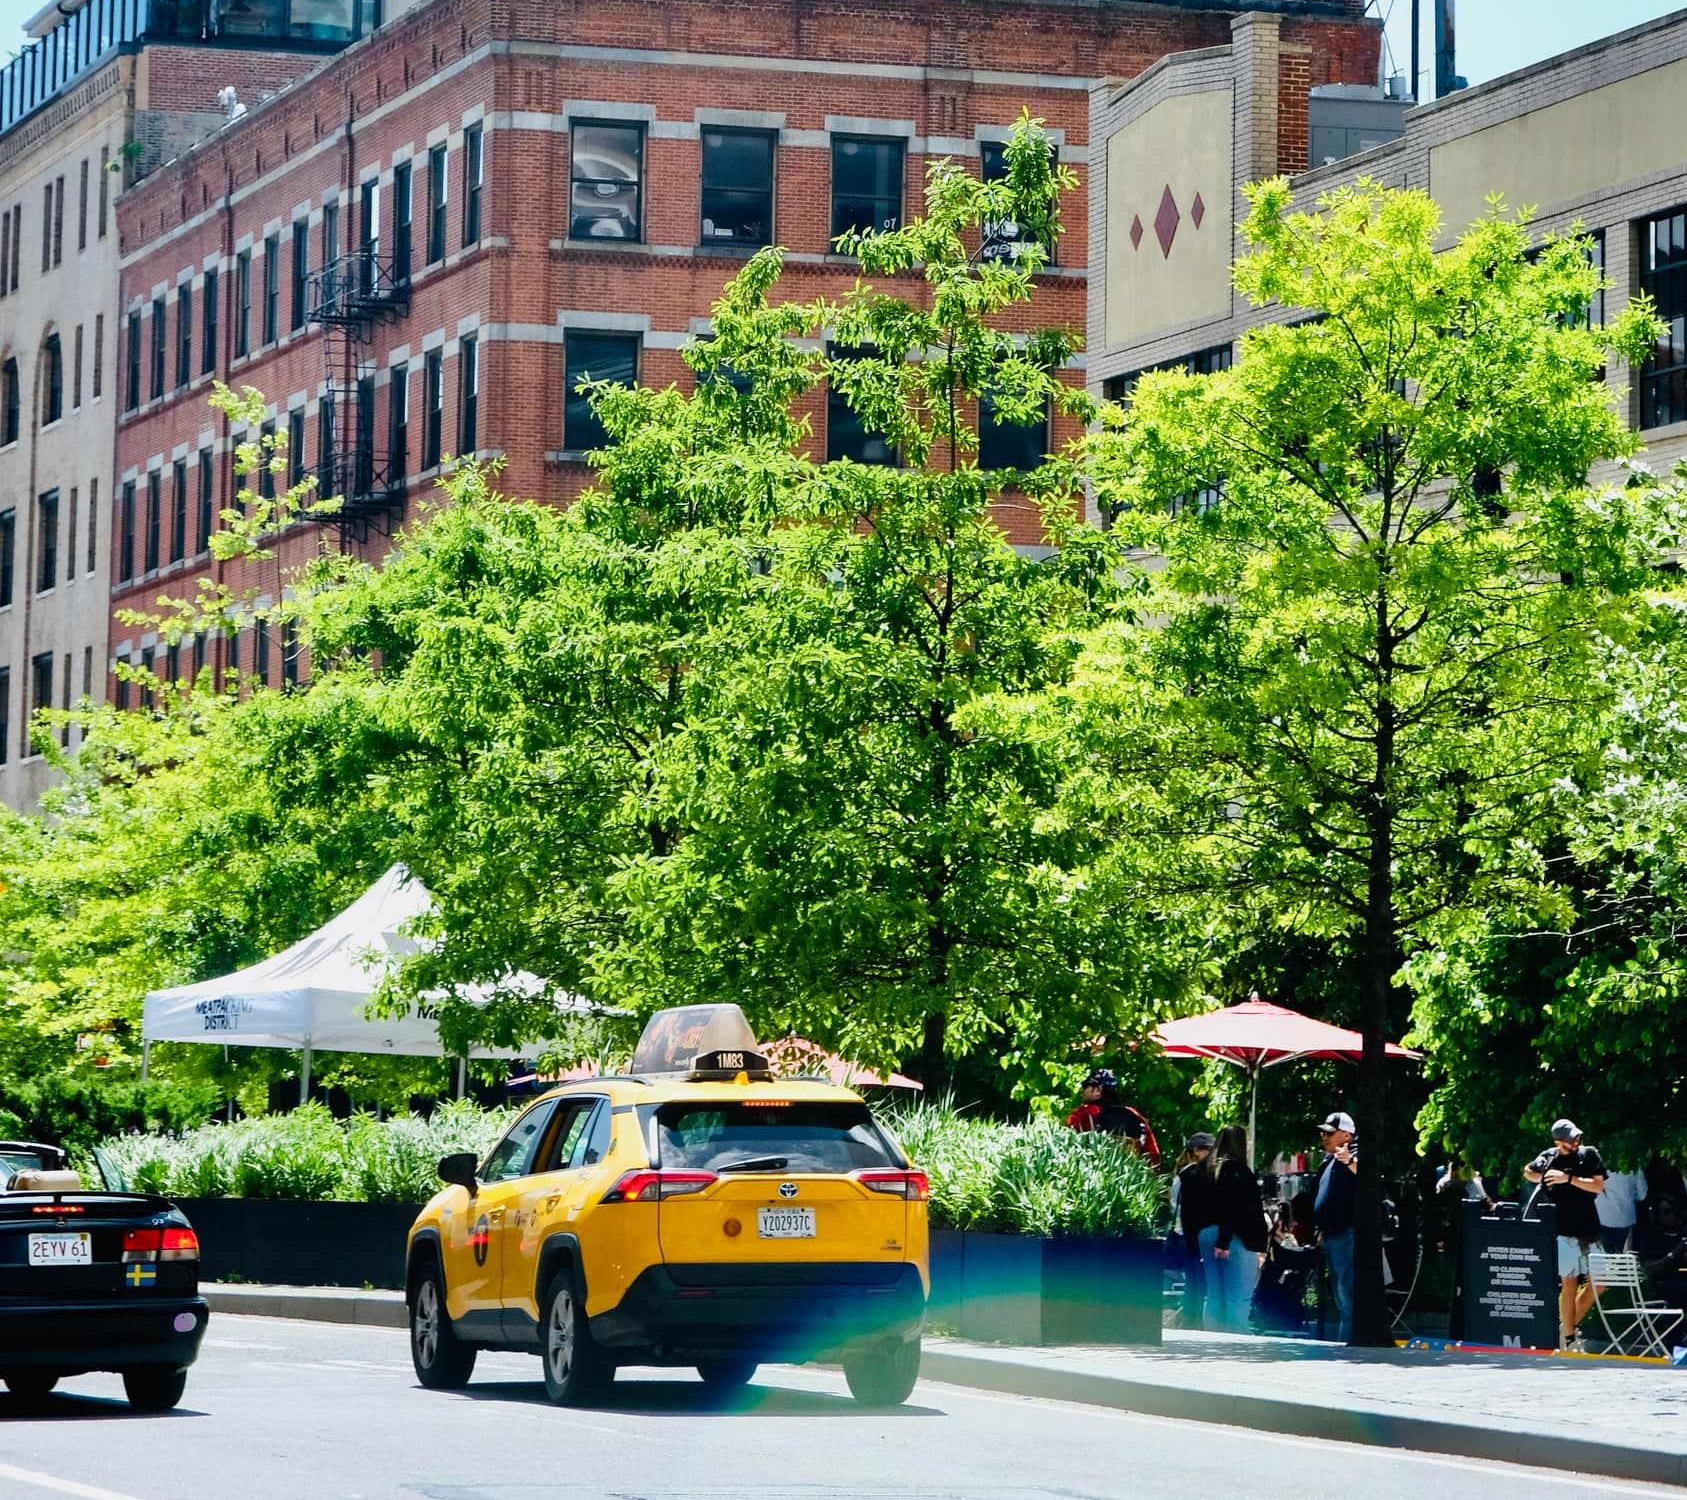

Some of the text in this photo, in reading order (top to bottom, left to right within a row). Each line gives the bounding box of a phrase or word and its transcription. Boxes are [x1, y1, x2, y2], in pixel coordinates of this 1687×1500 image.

[195, 998, 254, 1014] MEATPACKING
[204, 1014, 240, 1030] DISTRICT
[716, 1053, 744, 1069] 1M83
[763, 1215, 811, 1231] Y202937C
[33, 1241, 89, 1258] 2EYV 61
[1502, 1334, 1522, 1348] M
